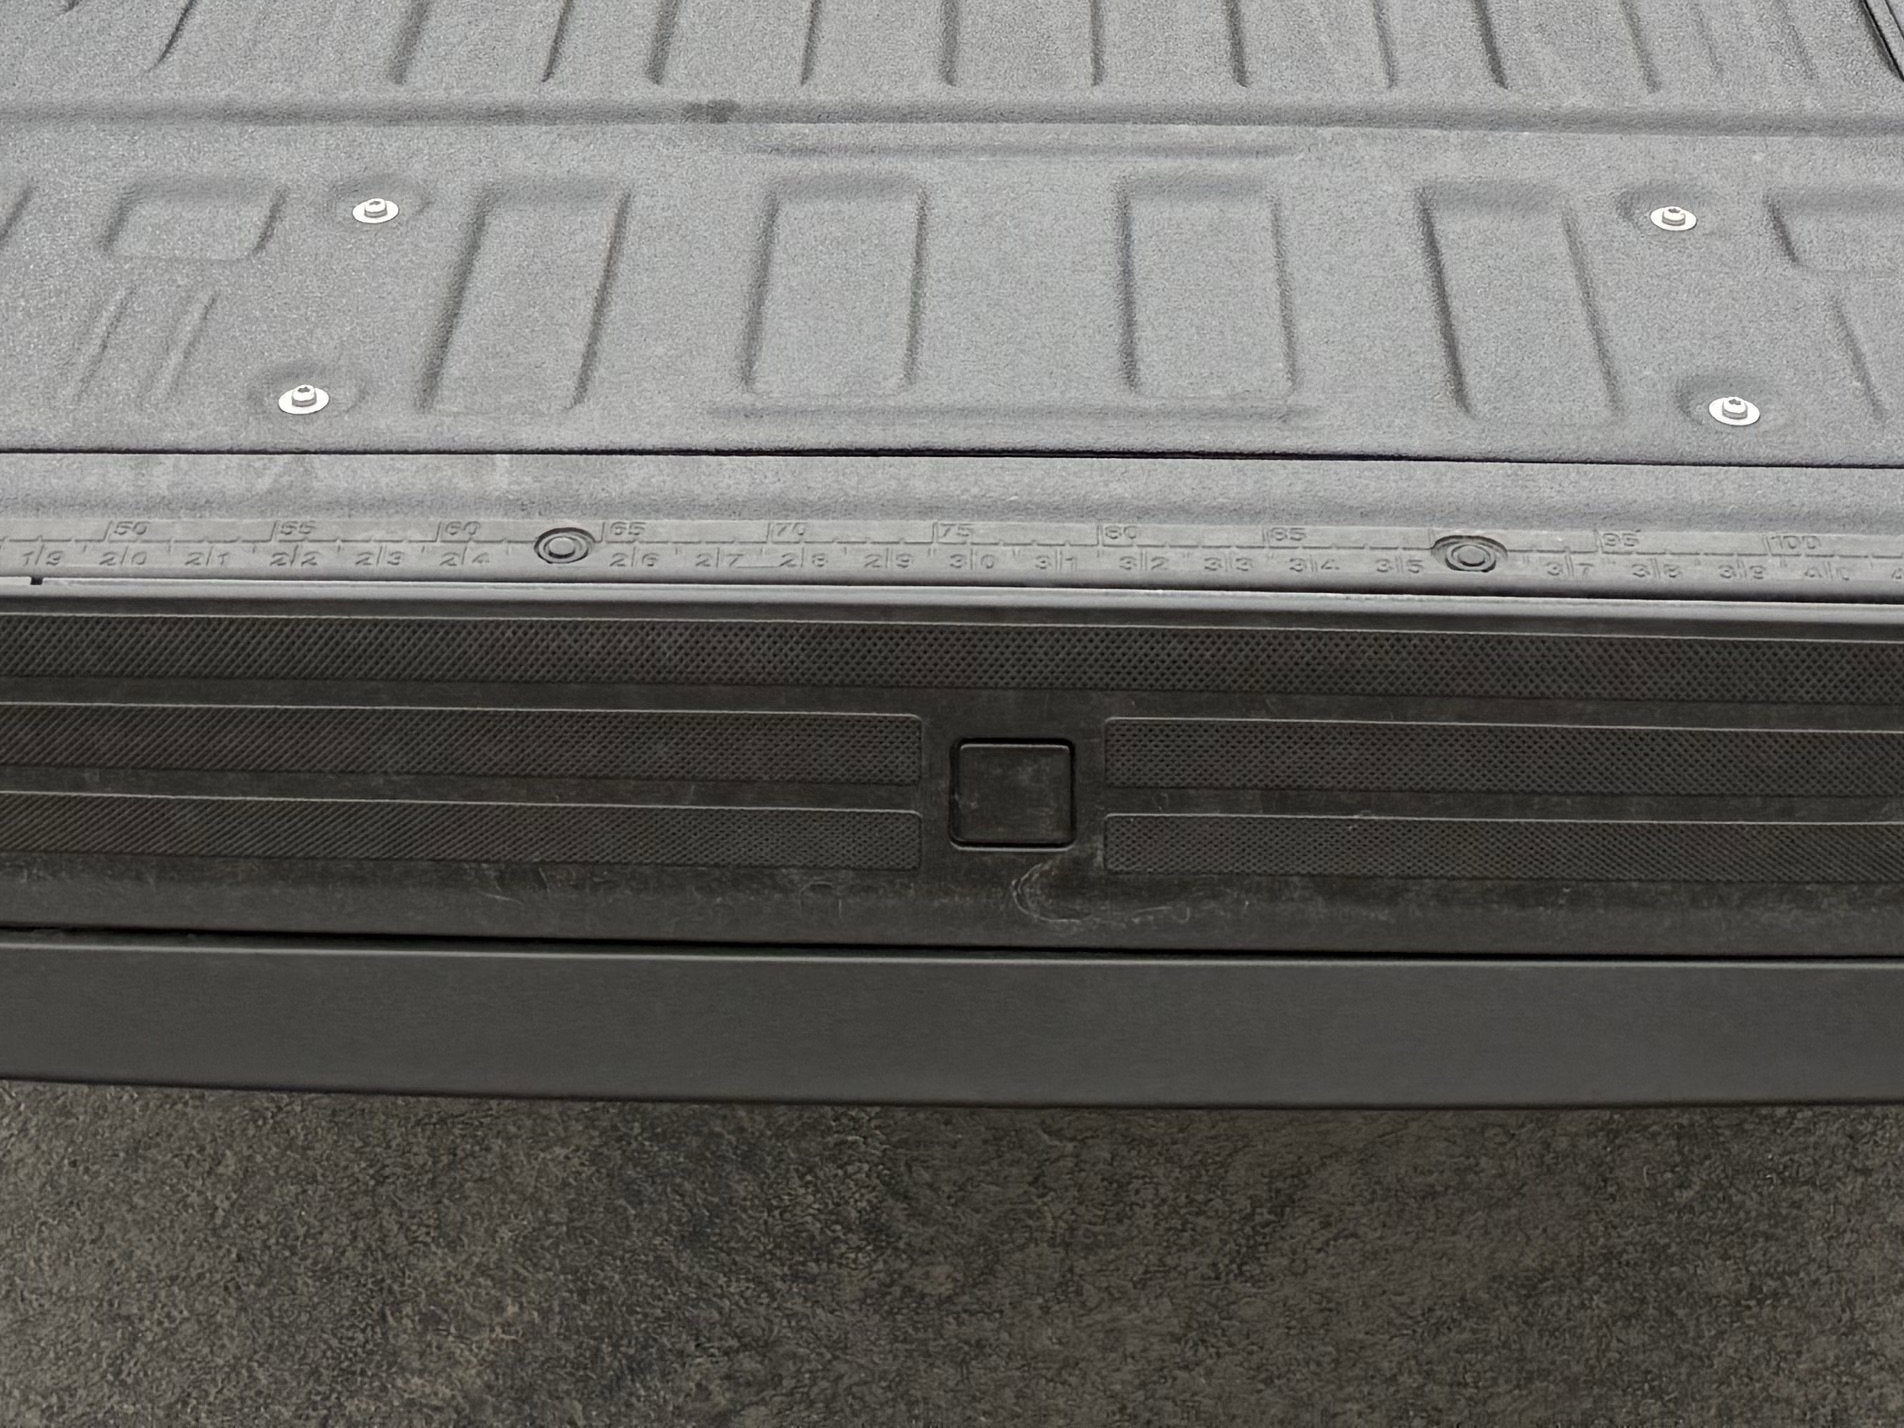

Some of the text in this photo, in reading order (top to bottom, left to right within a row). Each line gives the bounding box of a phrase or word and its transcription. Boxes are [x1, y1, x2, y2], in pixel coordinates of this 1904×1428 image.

[113, 521, 151, 535] 50
[279, 520, 316, 535] 55
[444, 521, 481, 536] 60
[610, 521, 647, 536] 65
[776, 522, 809, 536] 70
[939, 523, 975, 537] 75
[1104, 526, 1140, 540] 80
[1271, 527, 1307, 542] 85
[1602, 533, 1640, 548] 95
[1770, 535, 1822, 550] 100
